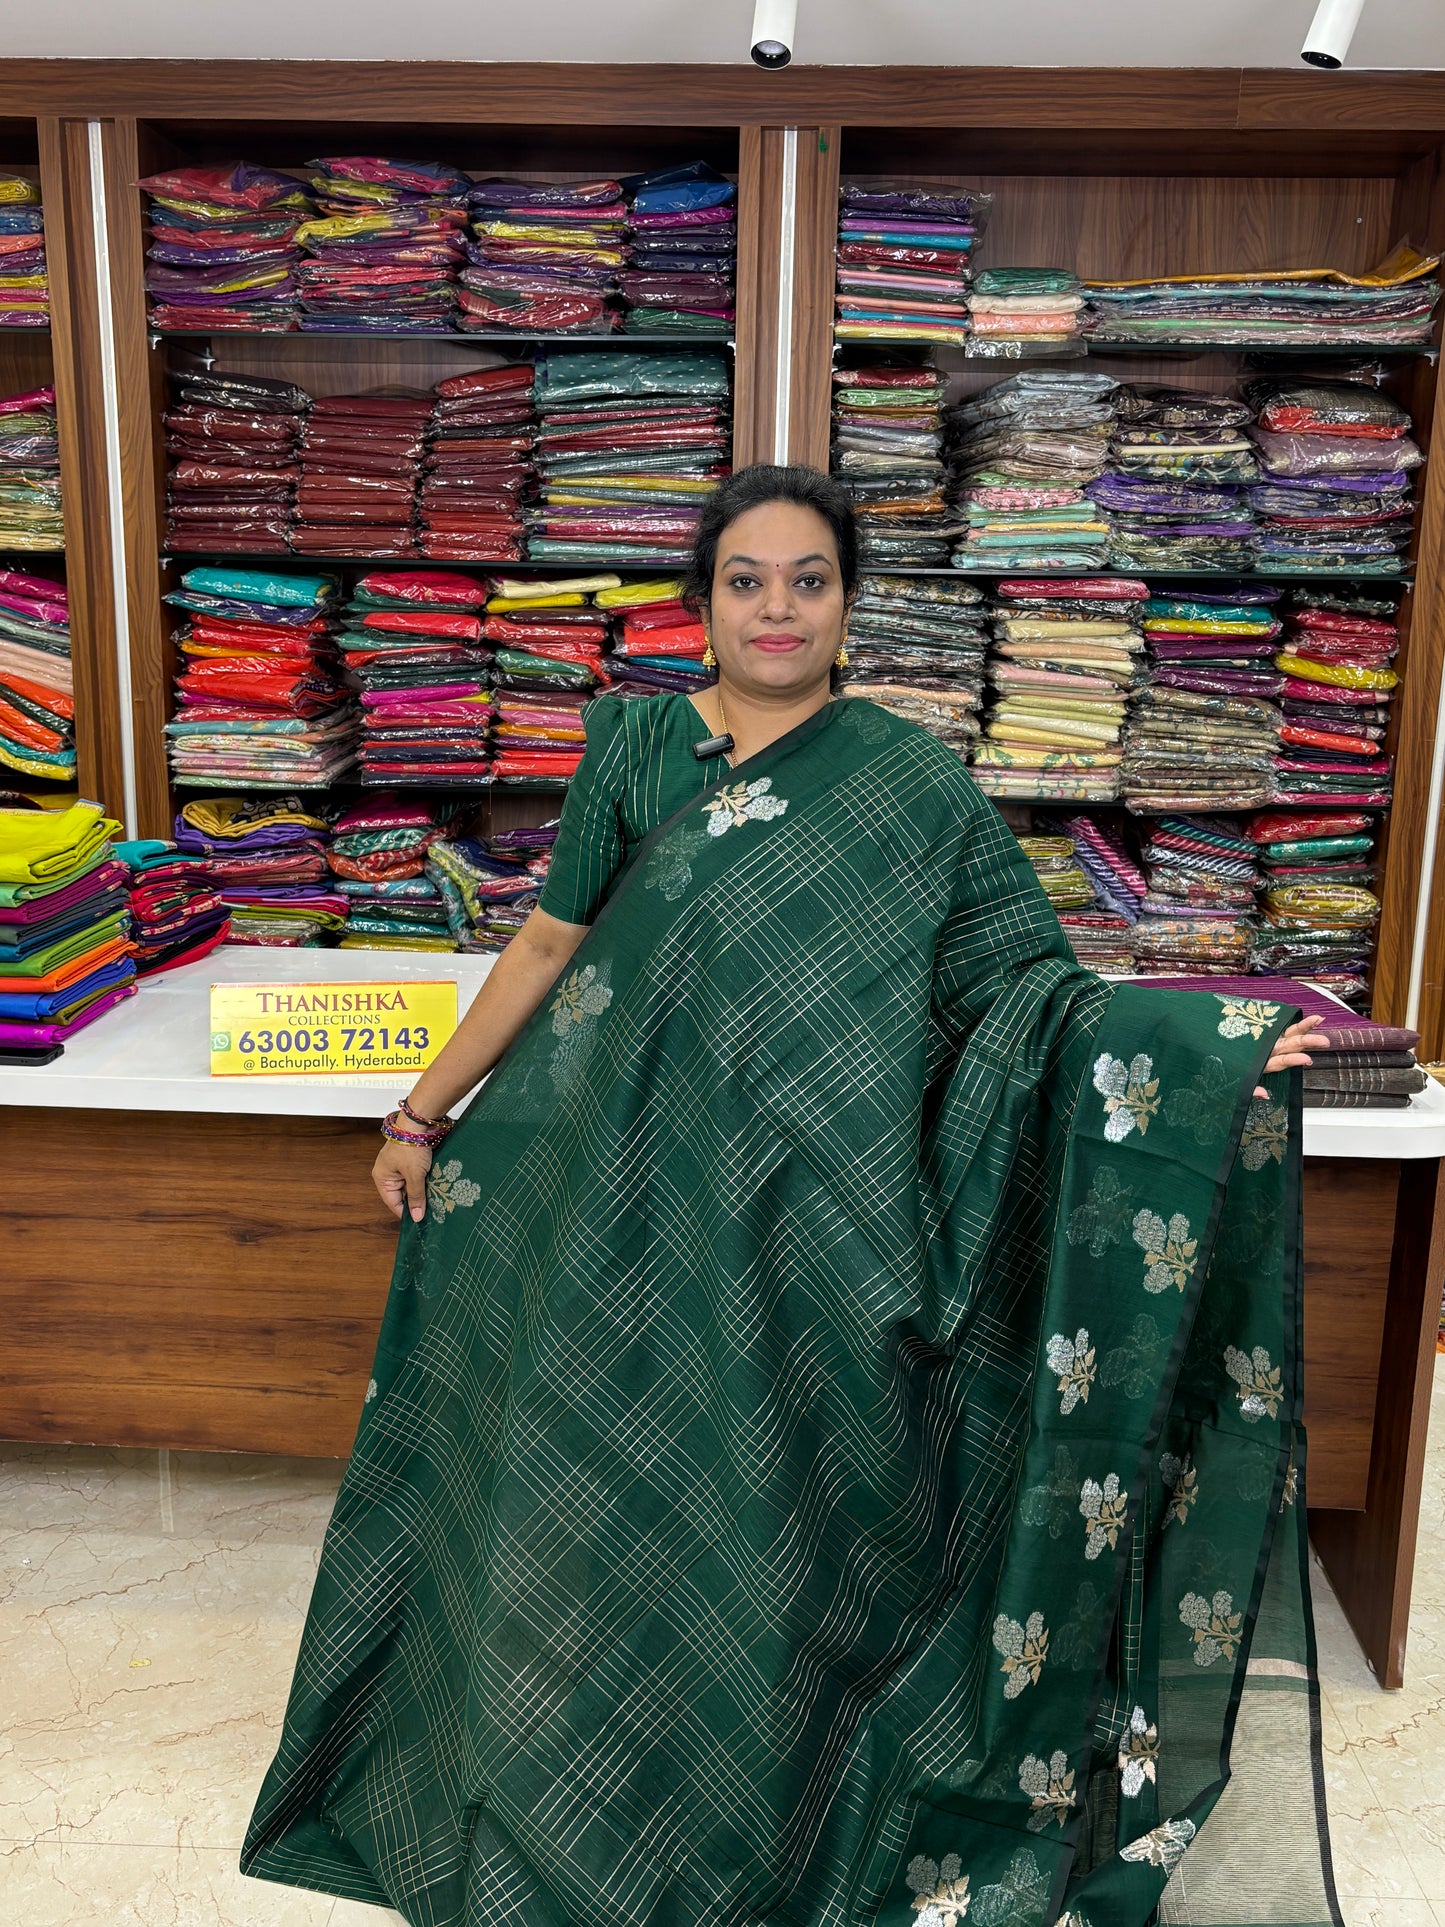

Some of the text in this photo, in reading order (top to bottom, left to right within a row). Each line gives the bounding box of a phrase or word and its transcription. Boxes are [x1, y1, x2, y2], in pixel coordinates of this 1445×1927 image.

[256, 991, 408, 1013] THANISHKA
[288, 1014, 381, 1026] COLLECTIONS
[239, 1027, 429, 1053] 63003 72143
[243, 1059, 255, 1071] @
[344, 1052, 425, 1069] Hyderabad.
